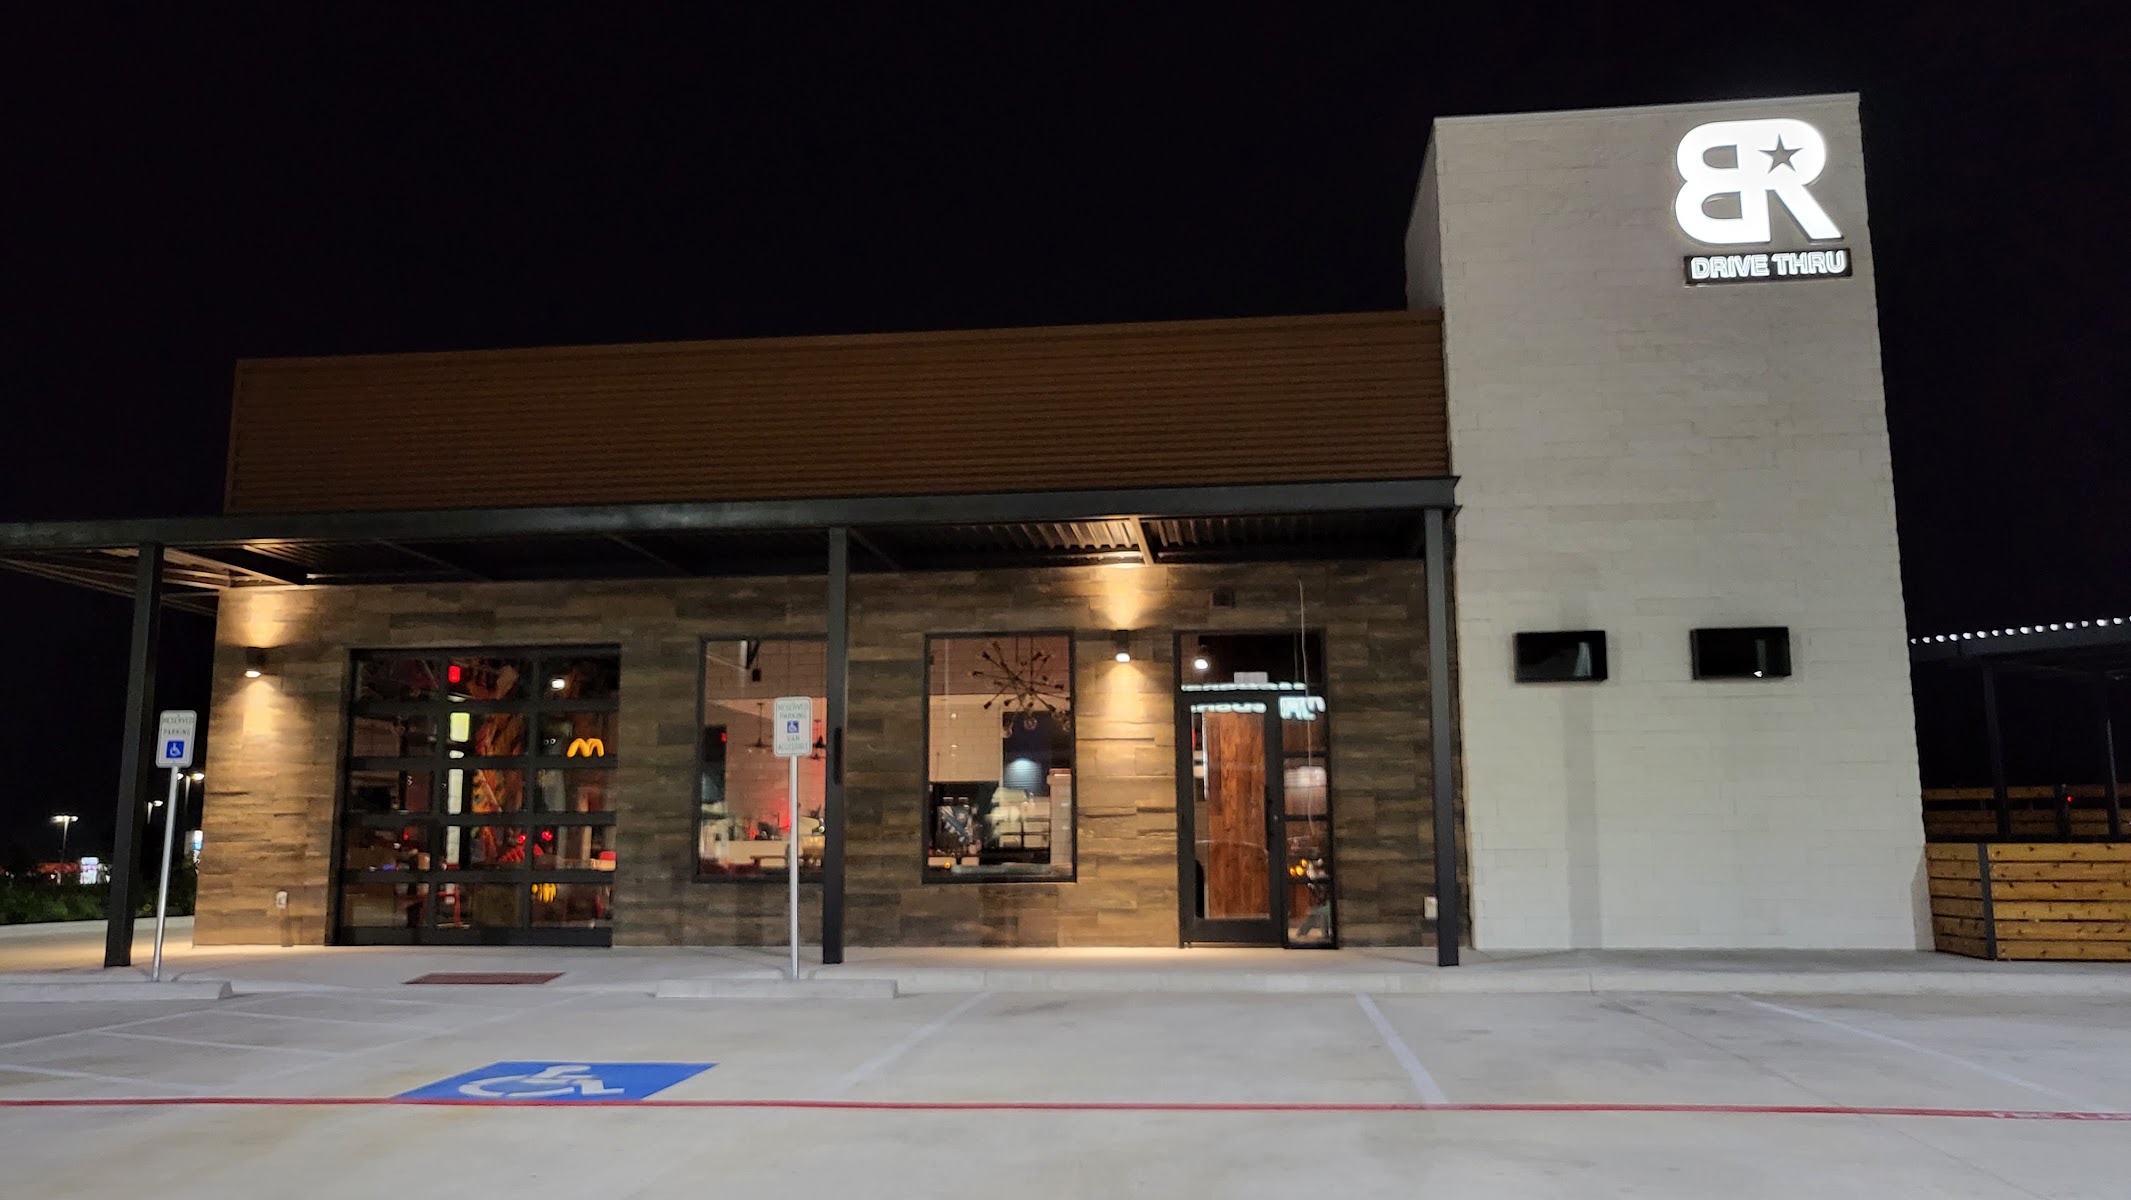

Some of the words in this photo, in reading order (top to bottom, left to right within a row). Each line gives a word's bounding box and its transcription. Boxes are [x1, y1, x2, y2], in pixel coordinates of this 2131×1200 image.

[1690, 254, 1770, 279] DRIVE
[1771, 250, 1847, 276] THRU
[777, 703, 809, 711] RESERVED
